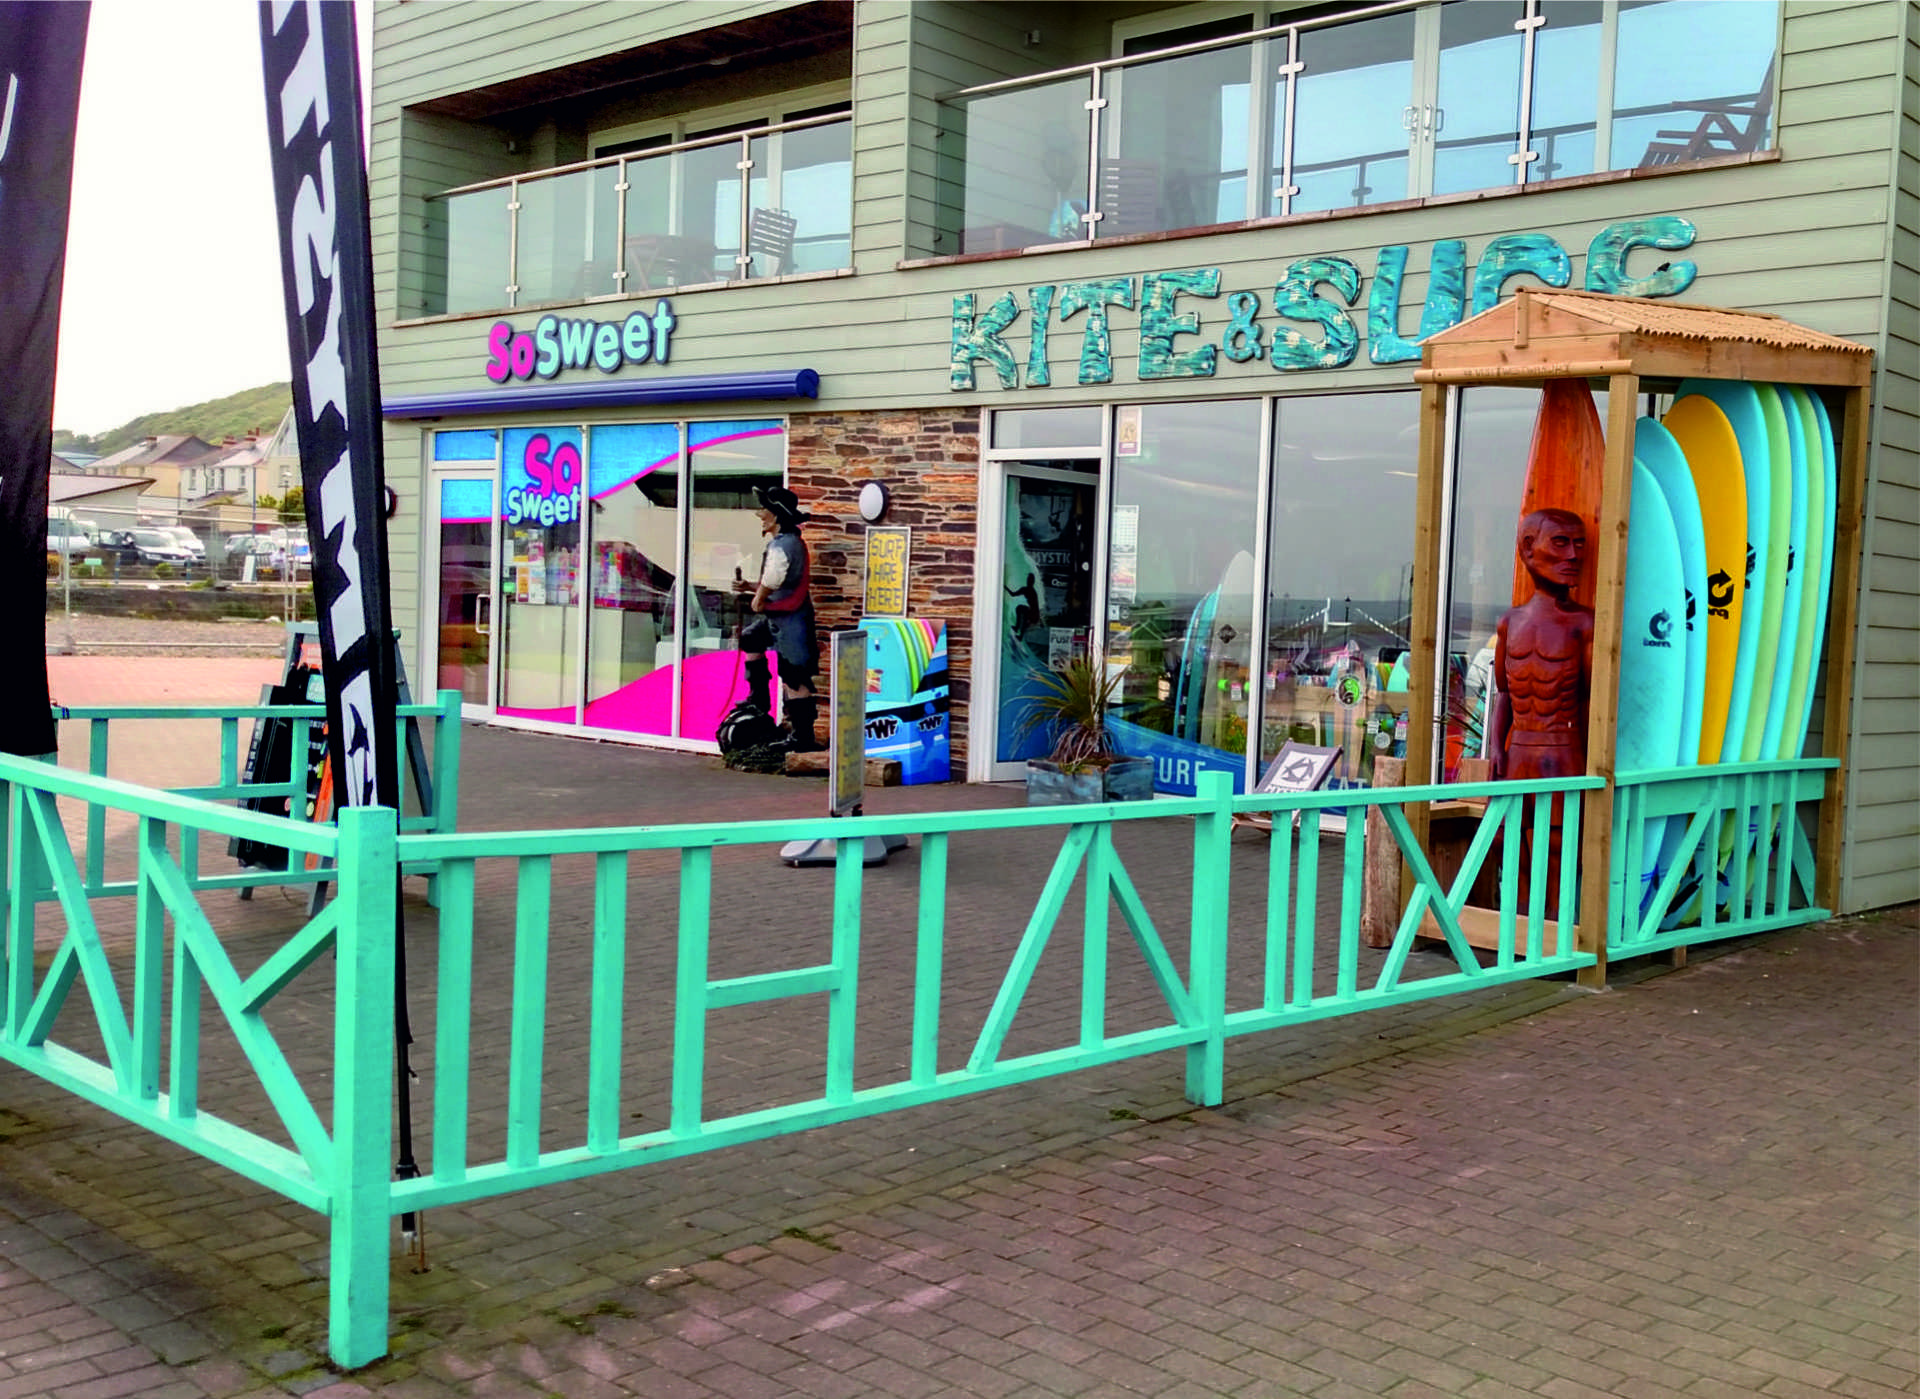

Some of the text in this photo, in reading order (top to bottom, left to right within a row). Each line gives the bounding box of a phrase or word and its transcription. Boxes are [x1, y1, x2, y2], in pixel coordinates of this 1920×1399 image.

[950, 267, 1221, 392] KITE
[871, 536, 904, 560] SURF
[873, 562, 898, 584] HIRE
[868, 586, 902, 609] HERE
[865, 718, 898, 739] TWF
[918, 715, 943, 731] TWF
